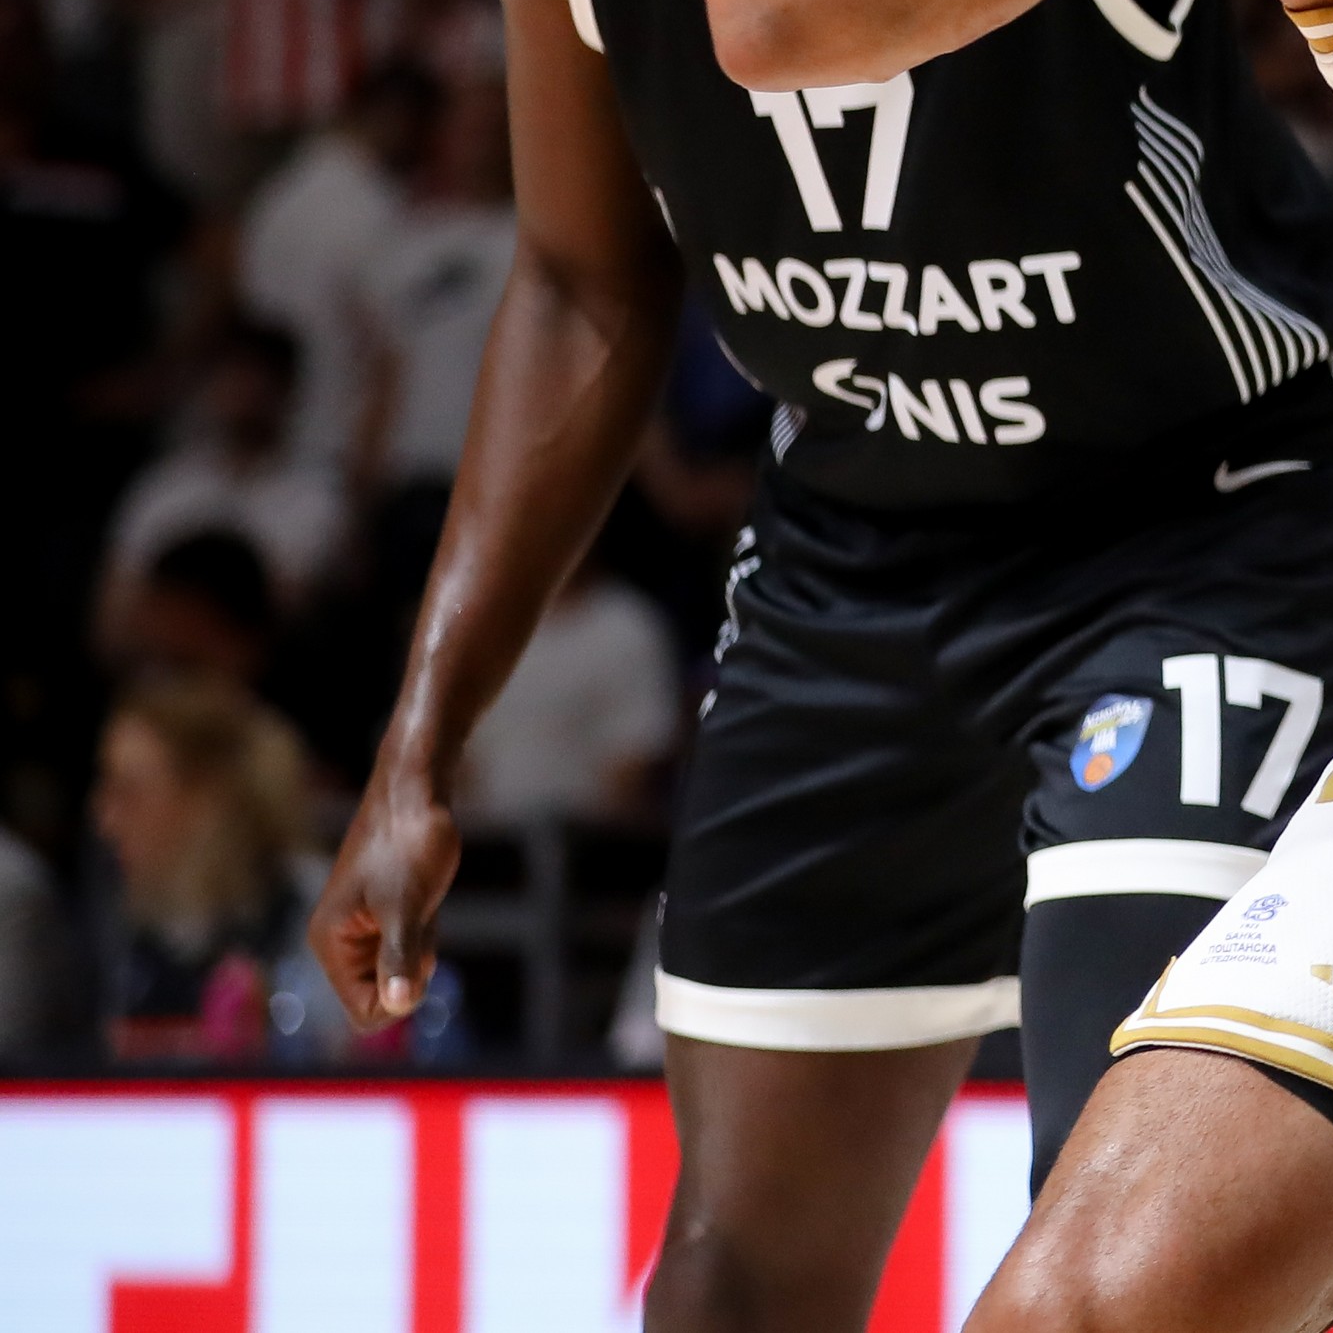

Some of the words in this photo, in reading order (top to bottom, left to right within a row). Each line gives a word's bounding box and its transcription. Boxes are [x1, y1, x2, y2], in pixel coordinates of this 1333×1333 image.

[748, 71, 915, 233] 17
[713, 251, 1082, 336] MOZZART
[887, 371, 1047, 446] NIS
[1162, 652, 1325, 822] 17
